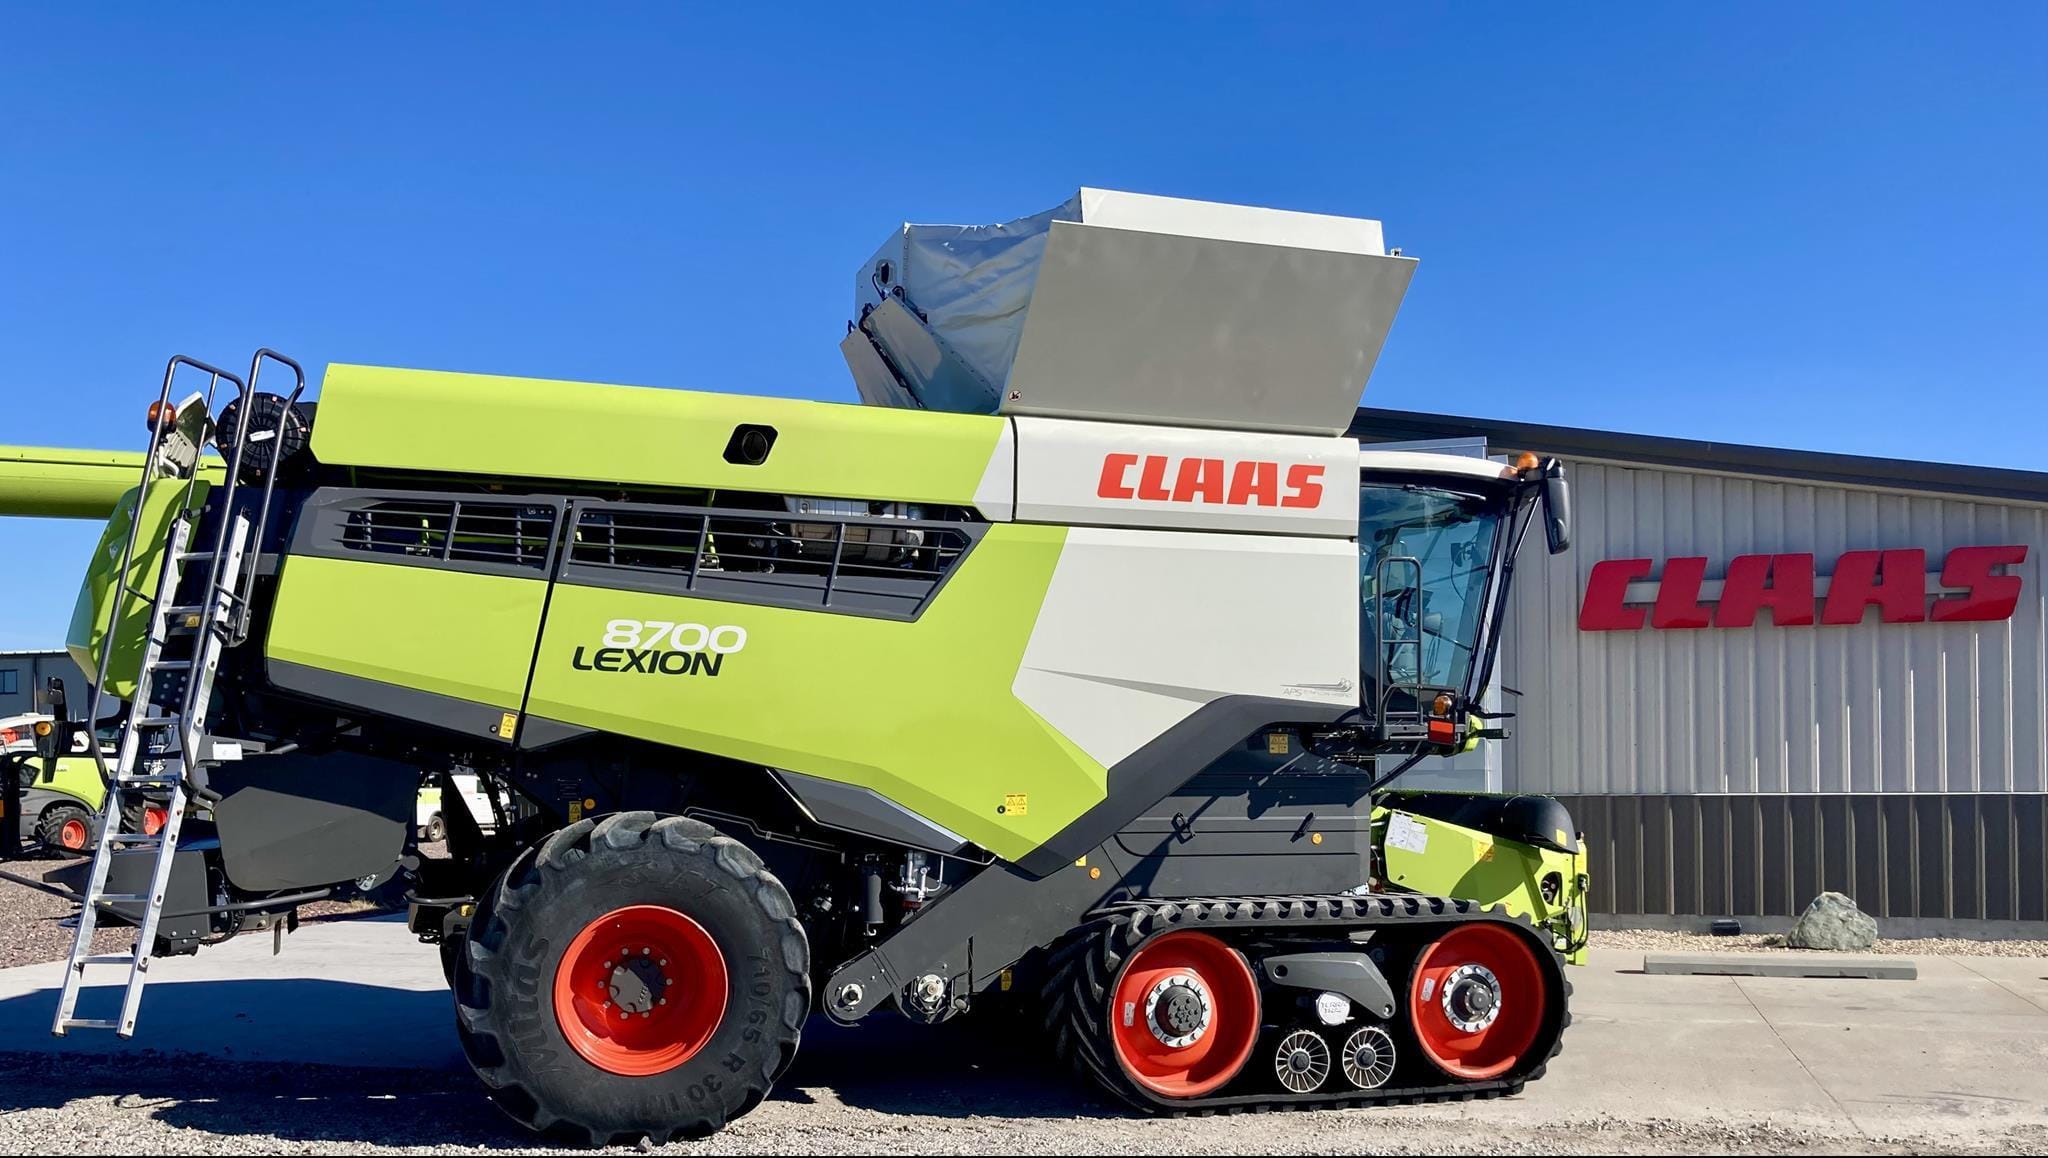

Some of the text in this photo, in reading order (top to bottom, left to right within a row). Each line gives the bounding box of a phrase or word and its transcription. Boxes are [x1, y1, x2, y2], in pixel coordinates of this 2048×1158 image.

[1097, 453, 1325, 509] CLAAS
[1578, 545, 2029, 632] CLAAS
[602, 619, 747, 654] 8700
[572, 646, 724, 677] LEXION
[722, 1051, 747, 1073] R
[686, 1073, 722, 1101] 30
